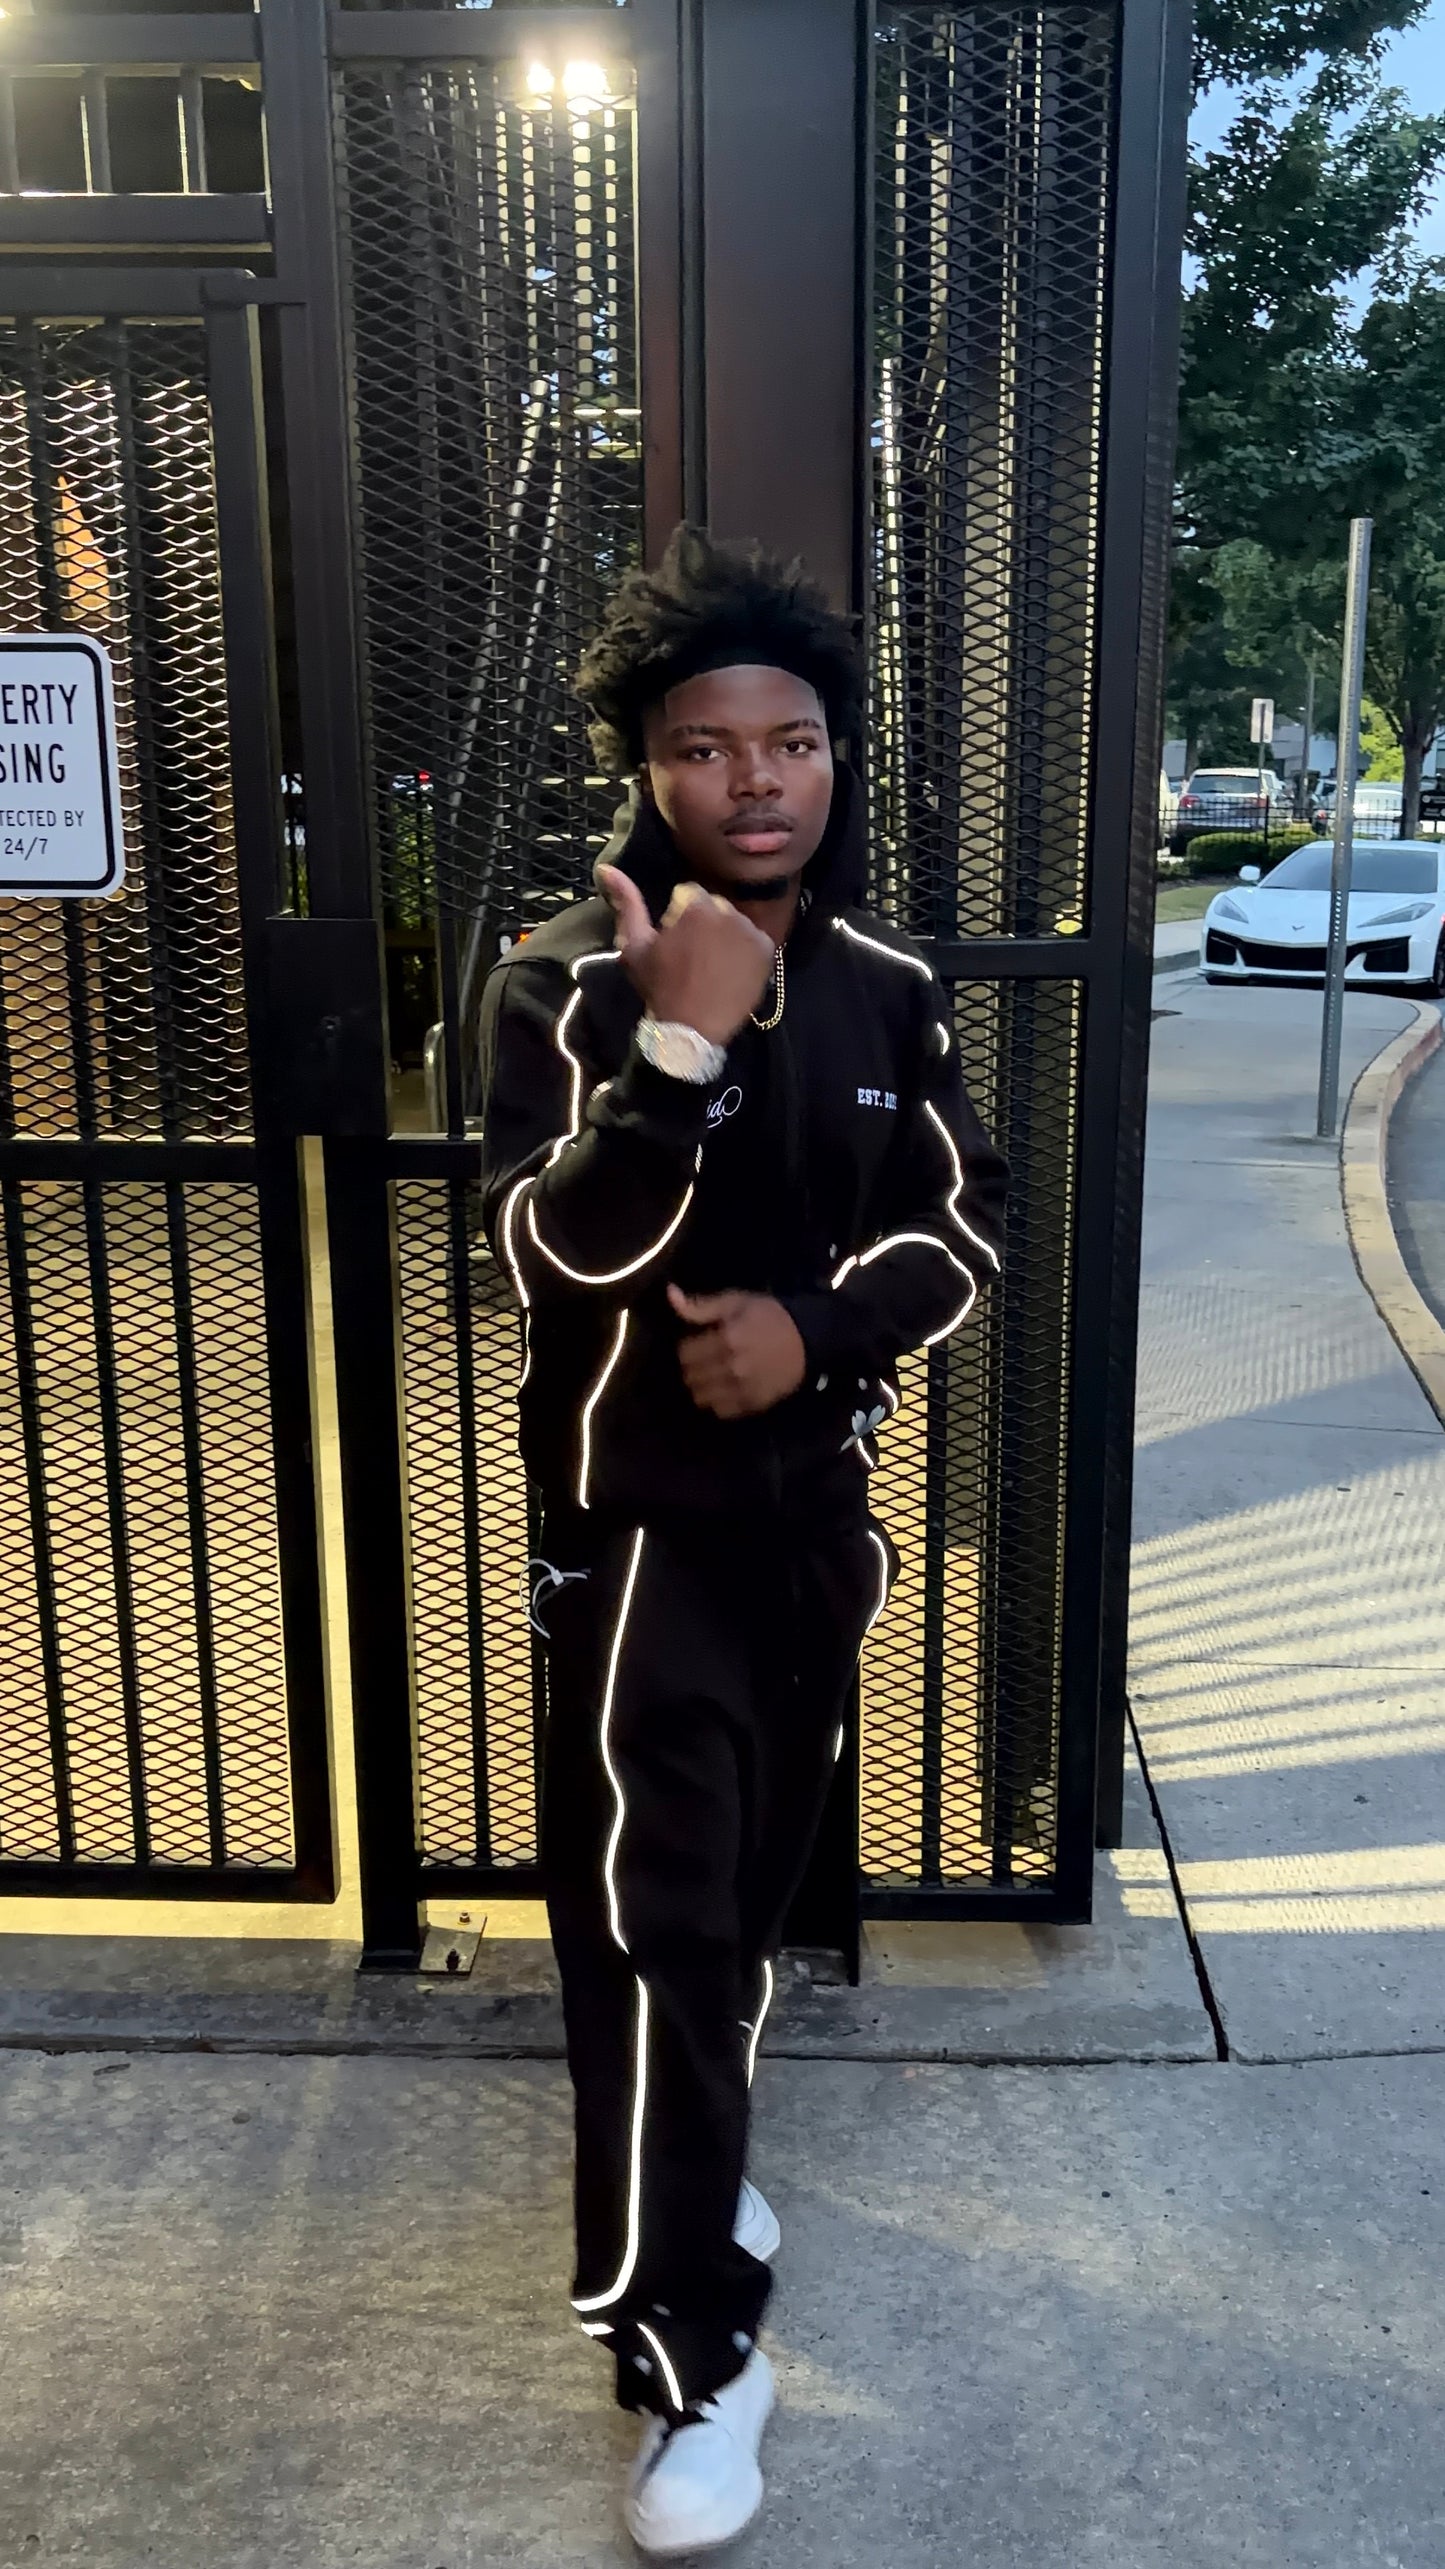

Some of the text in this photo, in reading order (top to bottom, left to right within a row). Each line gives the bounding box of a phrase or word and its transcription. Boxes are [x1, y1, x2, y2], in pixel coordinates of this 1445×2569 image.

[1, 684, 77, 724] ERTY
[64, 810, 84, 827] BY
[4, 837, 48, 861] 24/7
[857, 1087, 883, 1107] EST.
